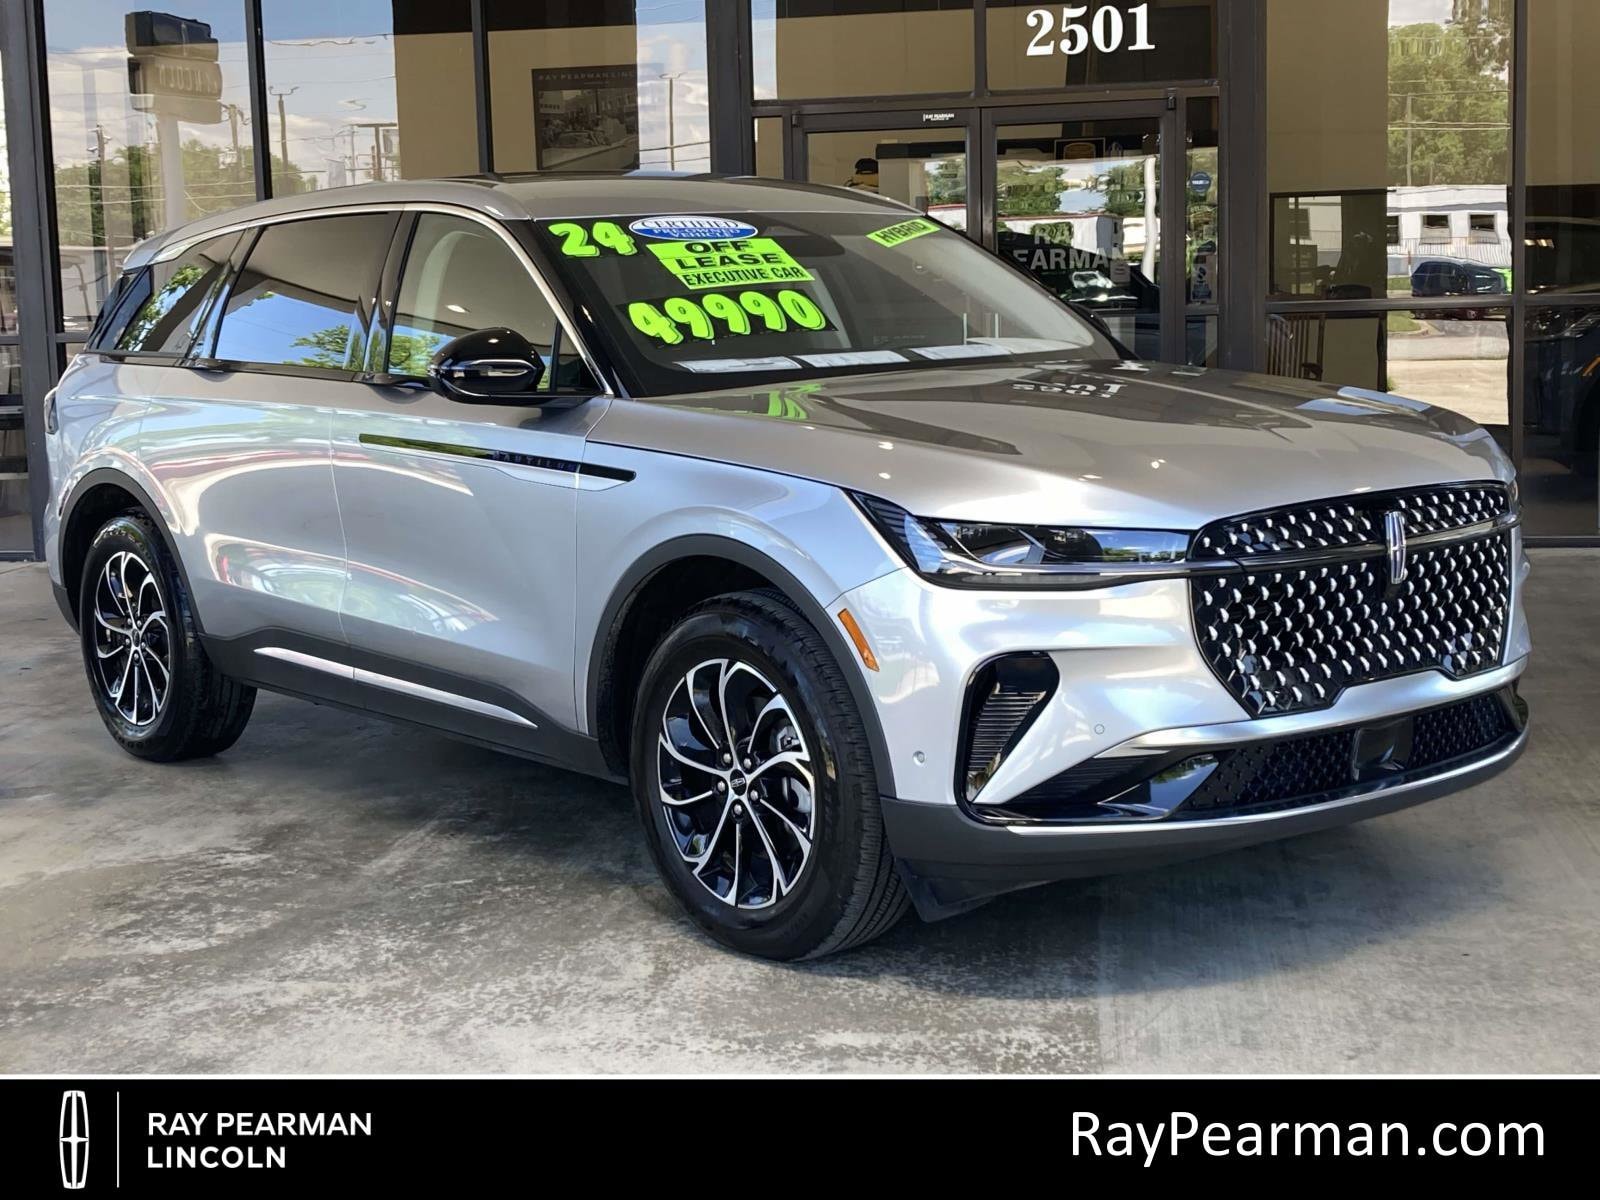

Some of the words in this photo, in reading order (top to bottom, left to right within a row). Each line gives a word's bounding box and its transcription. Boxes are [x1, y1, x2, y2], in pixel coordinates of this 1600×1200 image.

[1026, 3, 1156, 57] 2501
[641, 219, 739, 229] CERTIFIED
[875, 221, 930, 244] HYBRID
[548, 222, 638, 258] 24
[684, 240, 753, 254] OFF
[676, 253, 784, 270] LEASE
[682, 268, 770, 286] EXECUTIVE
[772, 266, 805, 279] CAR
[628, 290, 826, 345] 49990
